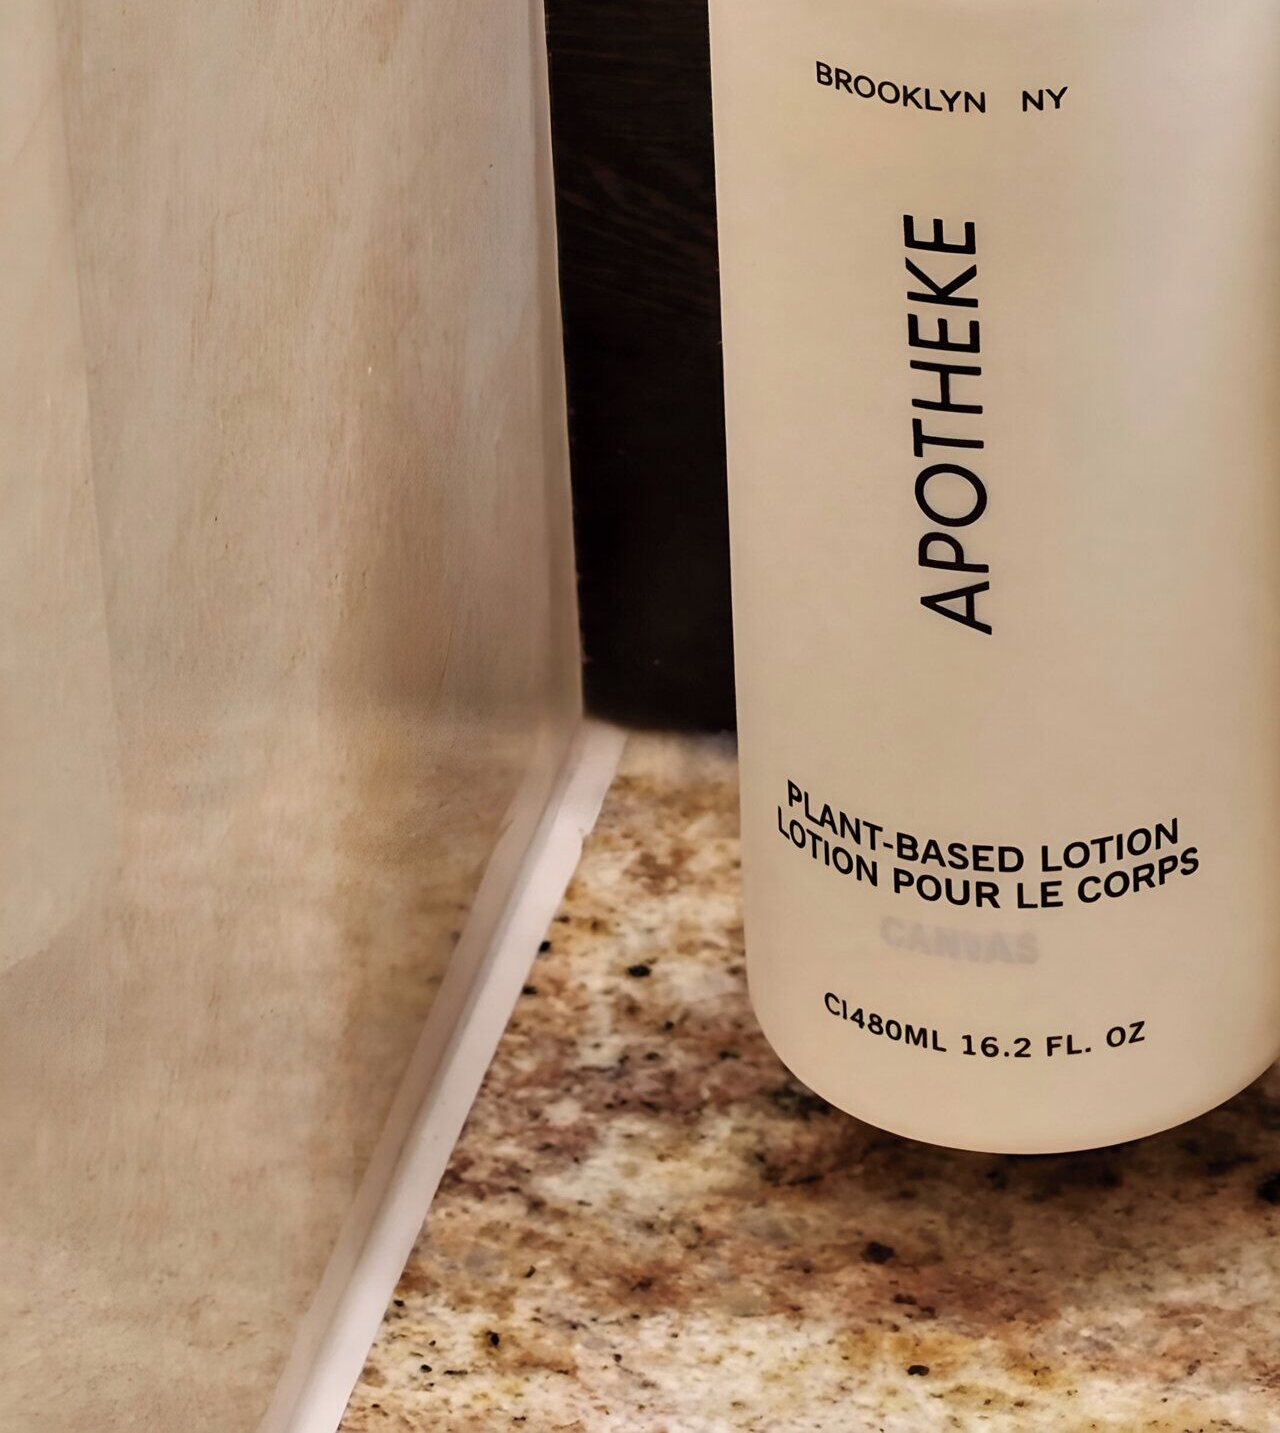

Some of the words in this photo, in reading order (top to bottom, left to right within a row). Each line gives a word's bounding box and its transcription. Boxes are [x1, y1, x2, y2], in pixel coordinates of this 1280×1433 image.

[815, 60, 986, 114] BROOKLYN
[1021, 86, 1069, 113] NY
[902, 214, 993, 636] APOTHEKE
[777, 805, 879, 887] LOTION
[893, 867, 1001, 909] POUR
[1016, 880, 1064, 909] LE
[1077, 846, 1200, 904] CORPS
[786, 779, 1025, 873] PLANT-BASED
[1041, 817, 1180, 873] LOTION
[961, 1034, 1032, 1058] 16.2
[1046, 1034, 1092, 1057] FL.
[1106, 1020, 1146, 1048] OZ
